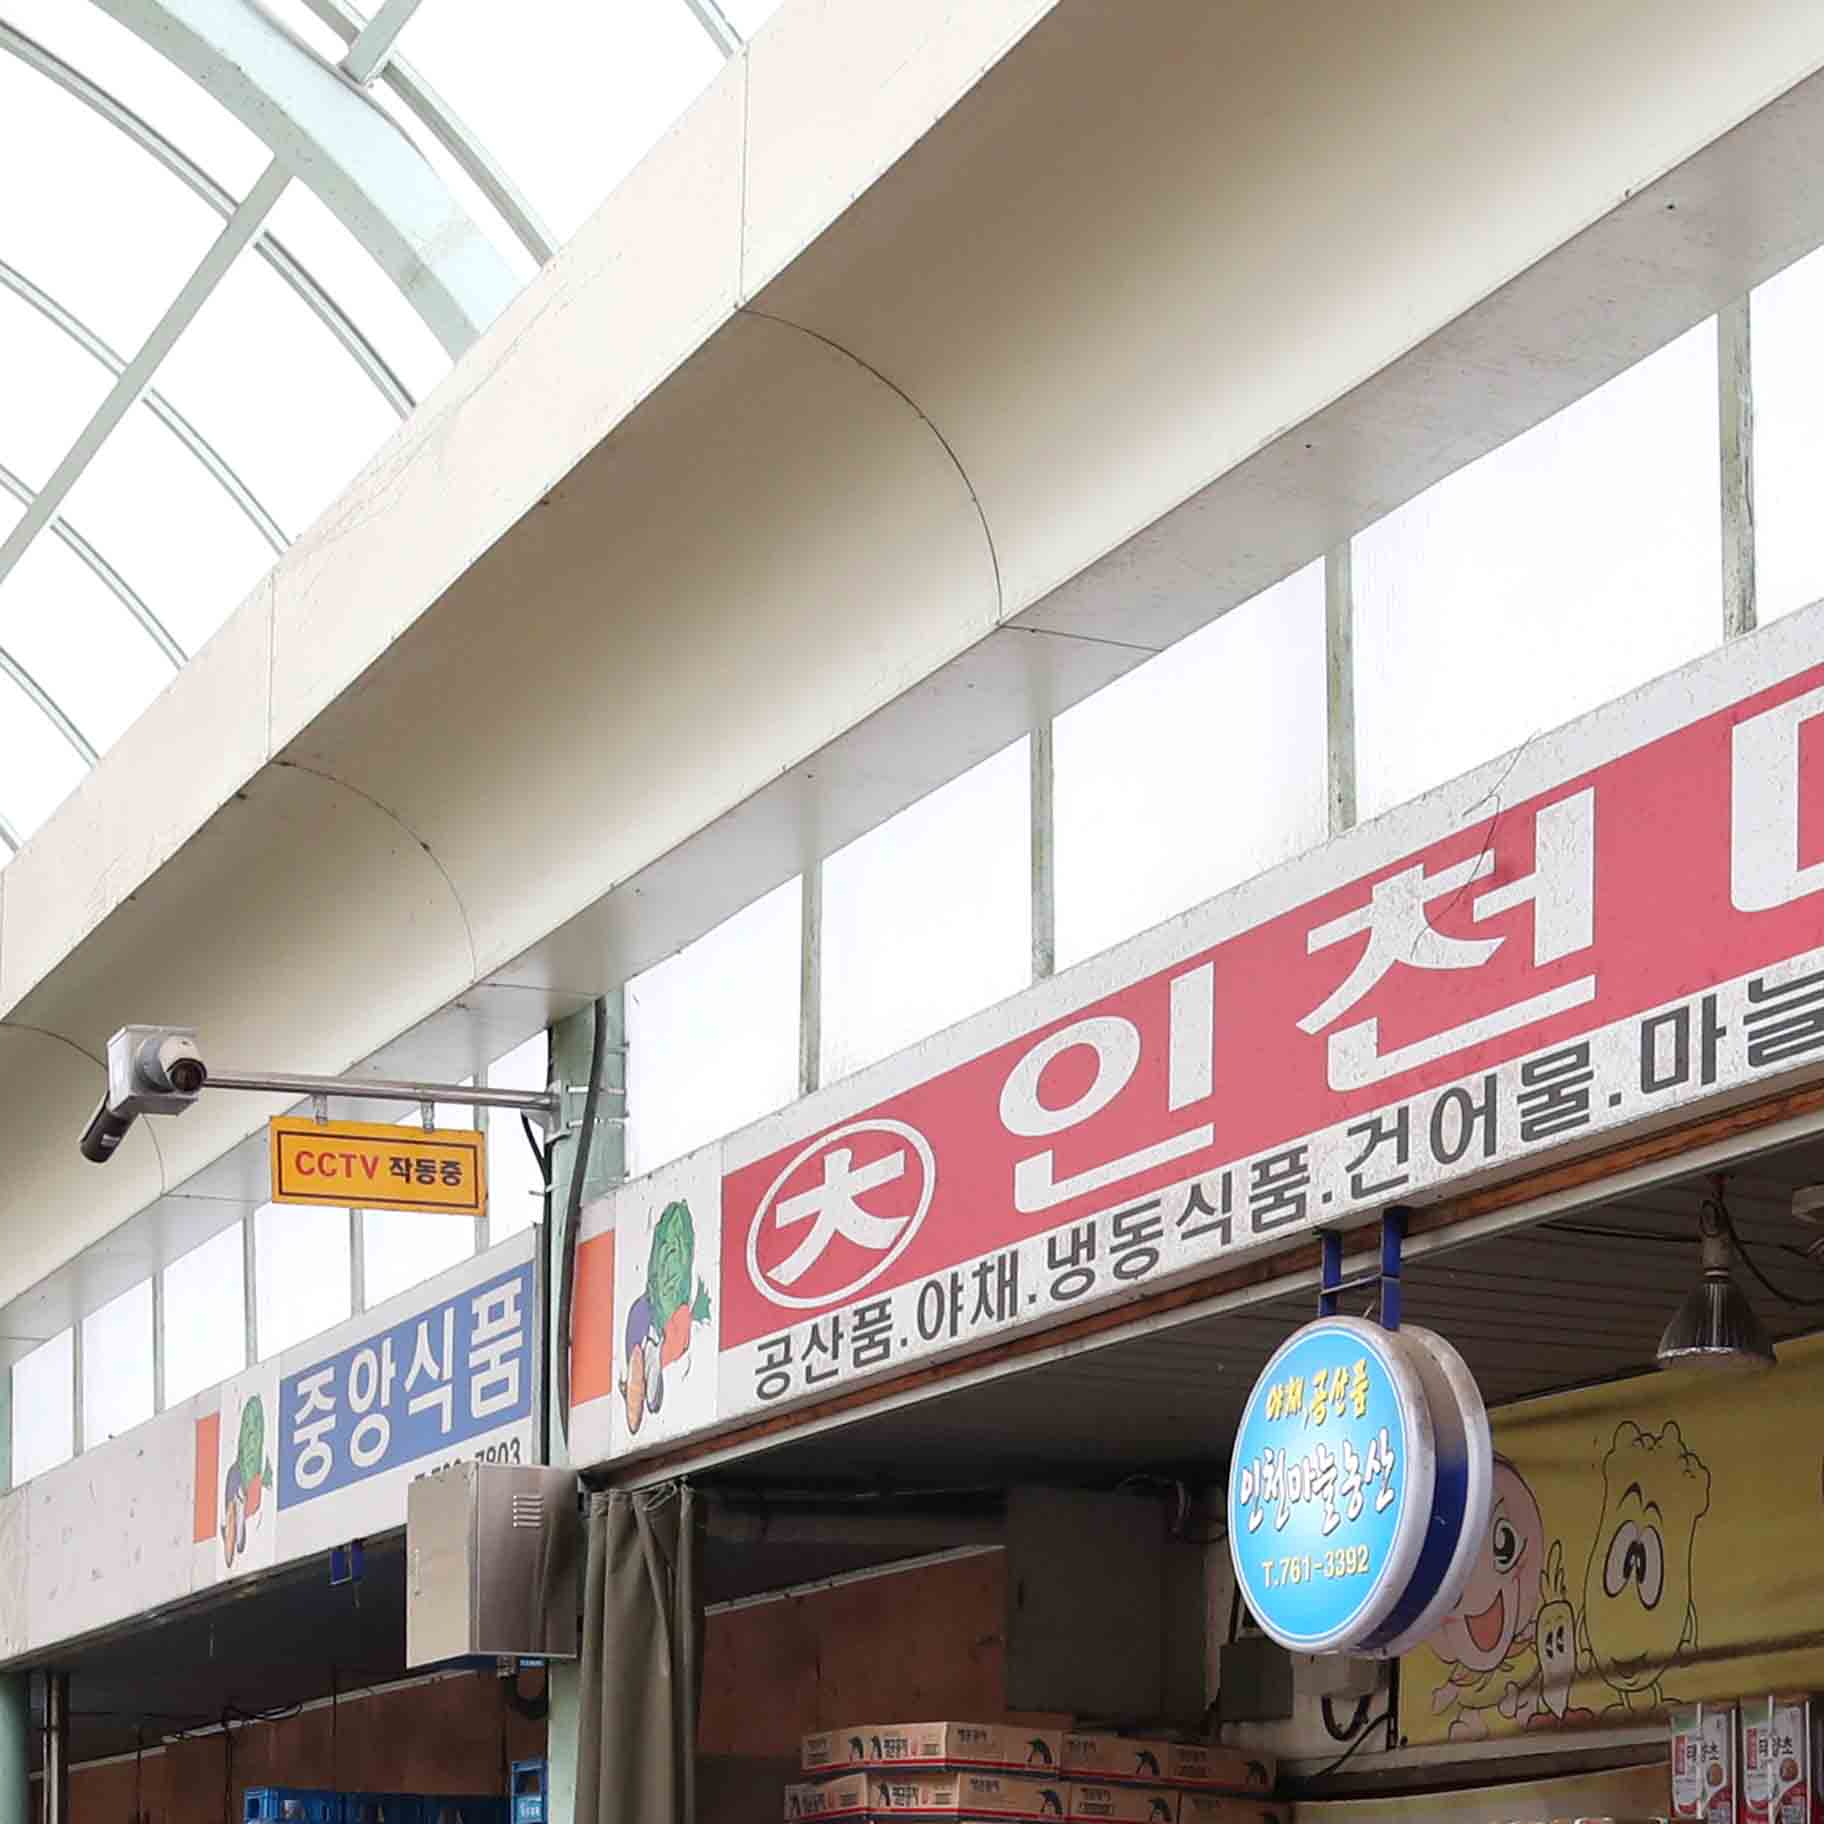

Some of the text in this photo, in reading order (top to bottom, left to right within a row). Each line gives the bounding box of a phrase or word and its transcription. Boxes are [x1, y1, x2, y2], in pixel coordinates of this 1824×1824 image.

[295, 1150, 463, 1187] CCTV 작동중
[293, 1276, 525, 1492] 중앙식품
